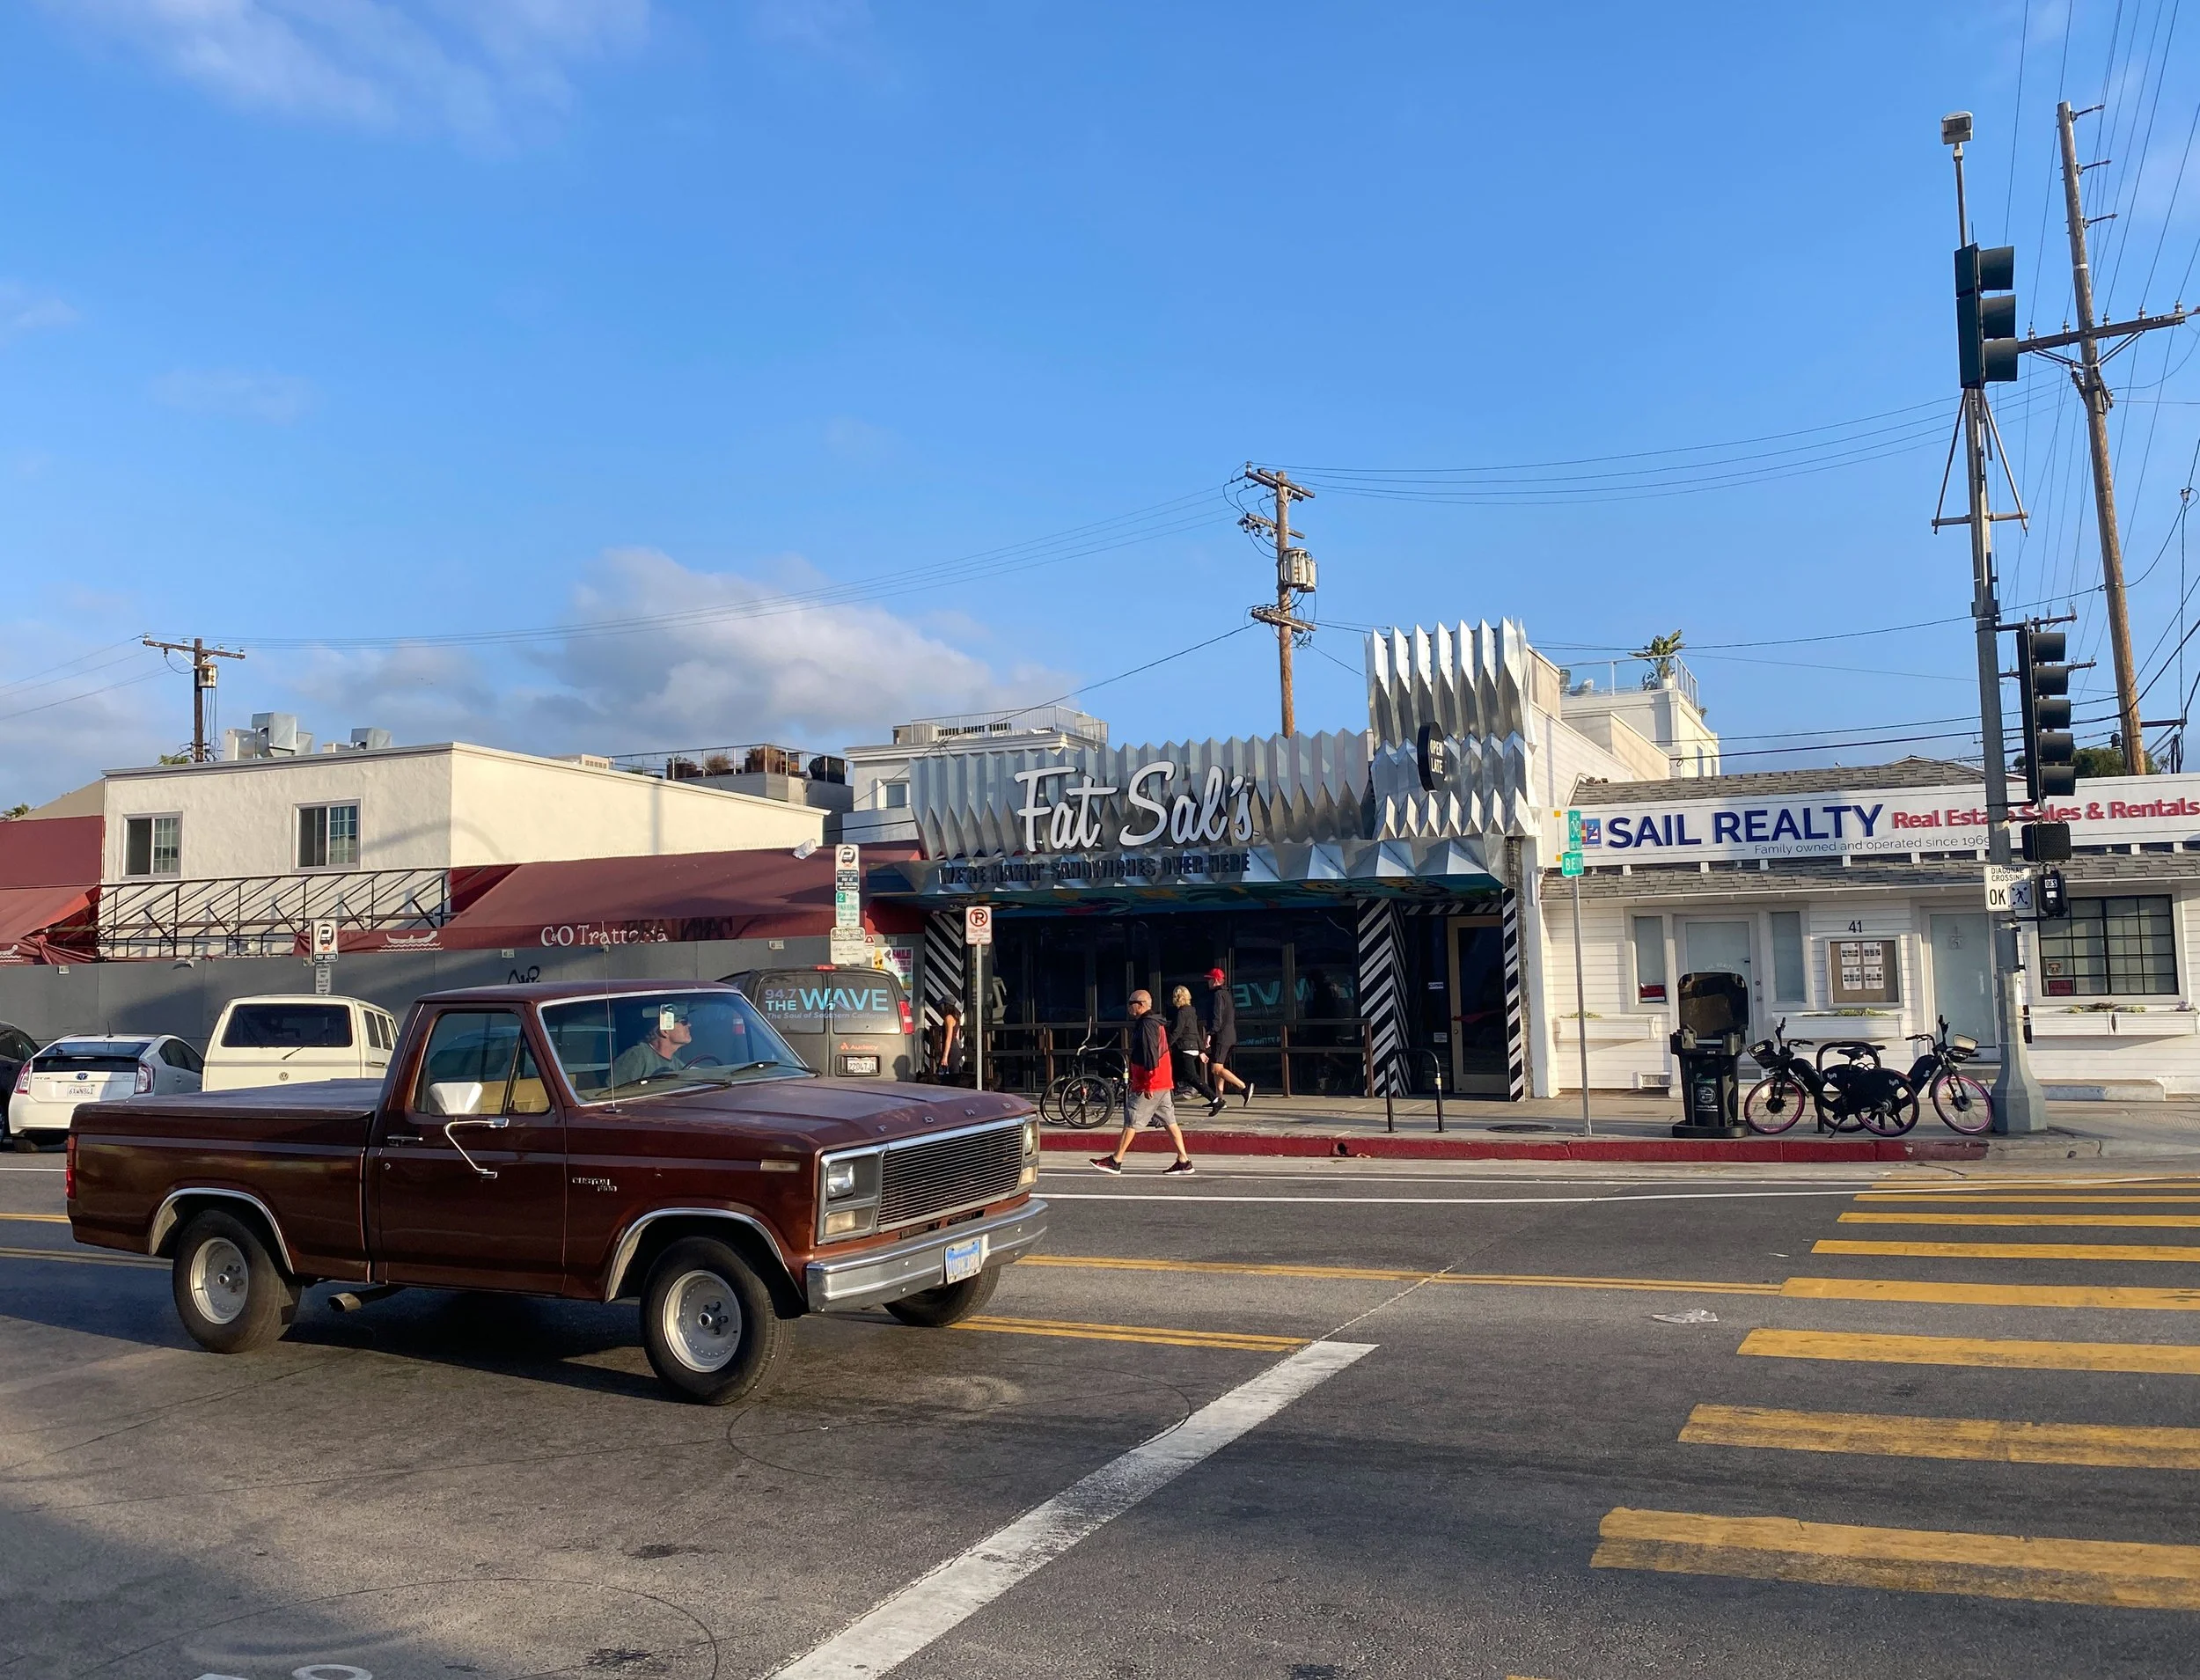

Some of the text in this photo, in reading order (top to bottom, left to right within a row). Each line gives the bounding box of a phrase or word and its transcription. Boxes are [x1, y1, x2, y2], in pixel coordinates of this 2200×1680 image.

[1430, 738, 1443, 757] OPEN
[1430, 757, 1443, 774] LATE
[1014, 759, 1253, 853] Fat Sal's
[1892, 809, 1942, 830] Real
[1945, 807, 2016, 827] Estae
[2086, 802, 2105, 820] &
[2108, 796, 2200, 820] Rentals
[1607, 803, 1884, 849] SAIL REALTY
[1755, 834, 1990, 855] Family owned and operated since 1969
[939, 852, 1250, 884] WE'RE MAKIN' SANDWICHES OVER HERE
[838, 892, 844, 902] 2
[1990, 889, 2006, 905] OK
[540, 924, 574, 947] C&O
[1848, 920, 1863, 933] 41
[765, 988, 796, 1000] 94.7
[798, 987, 889, 1011] WAVE
[766, 1000, 797, 1011] THE
